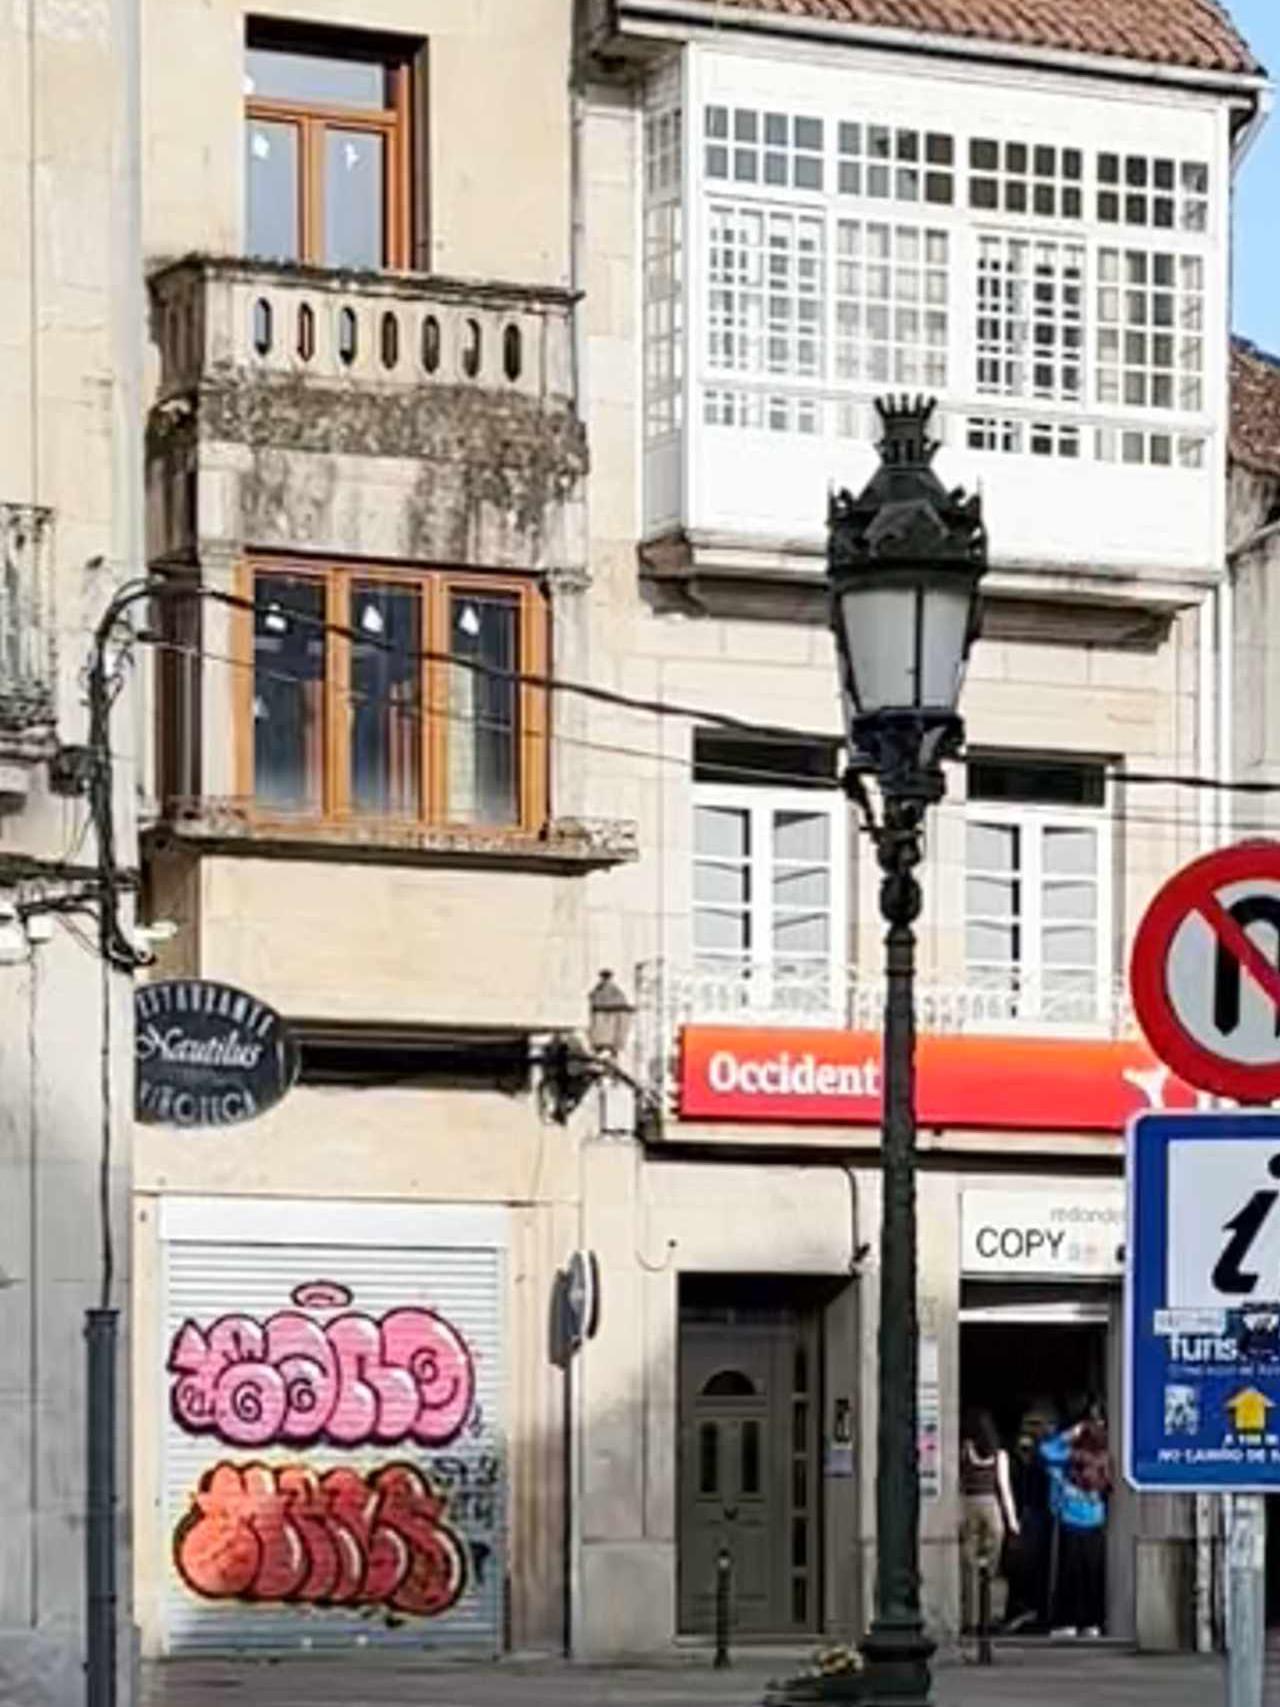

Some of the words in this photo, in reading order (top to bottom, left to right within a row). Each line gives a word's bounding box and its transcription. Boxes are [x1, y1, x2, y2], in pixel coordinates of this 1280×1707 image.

[708, 1049, 883, 1097] Occident
[975, 1226, 1066, 1259] COPY
[1246, 1449, 1266, 1464] DE
